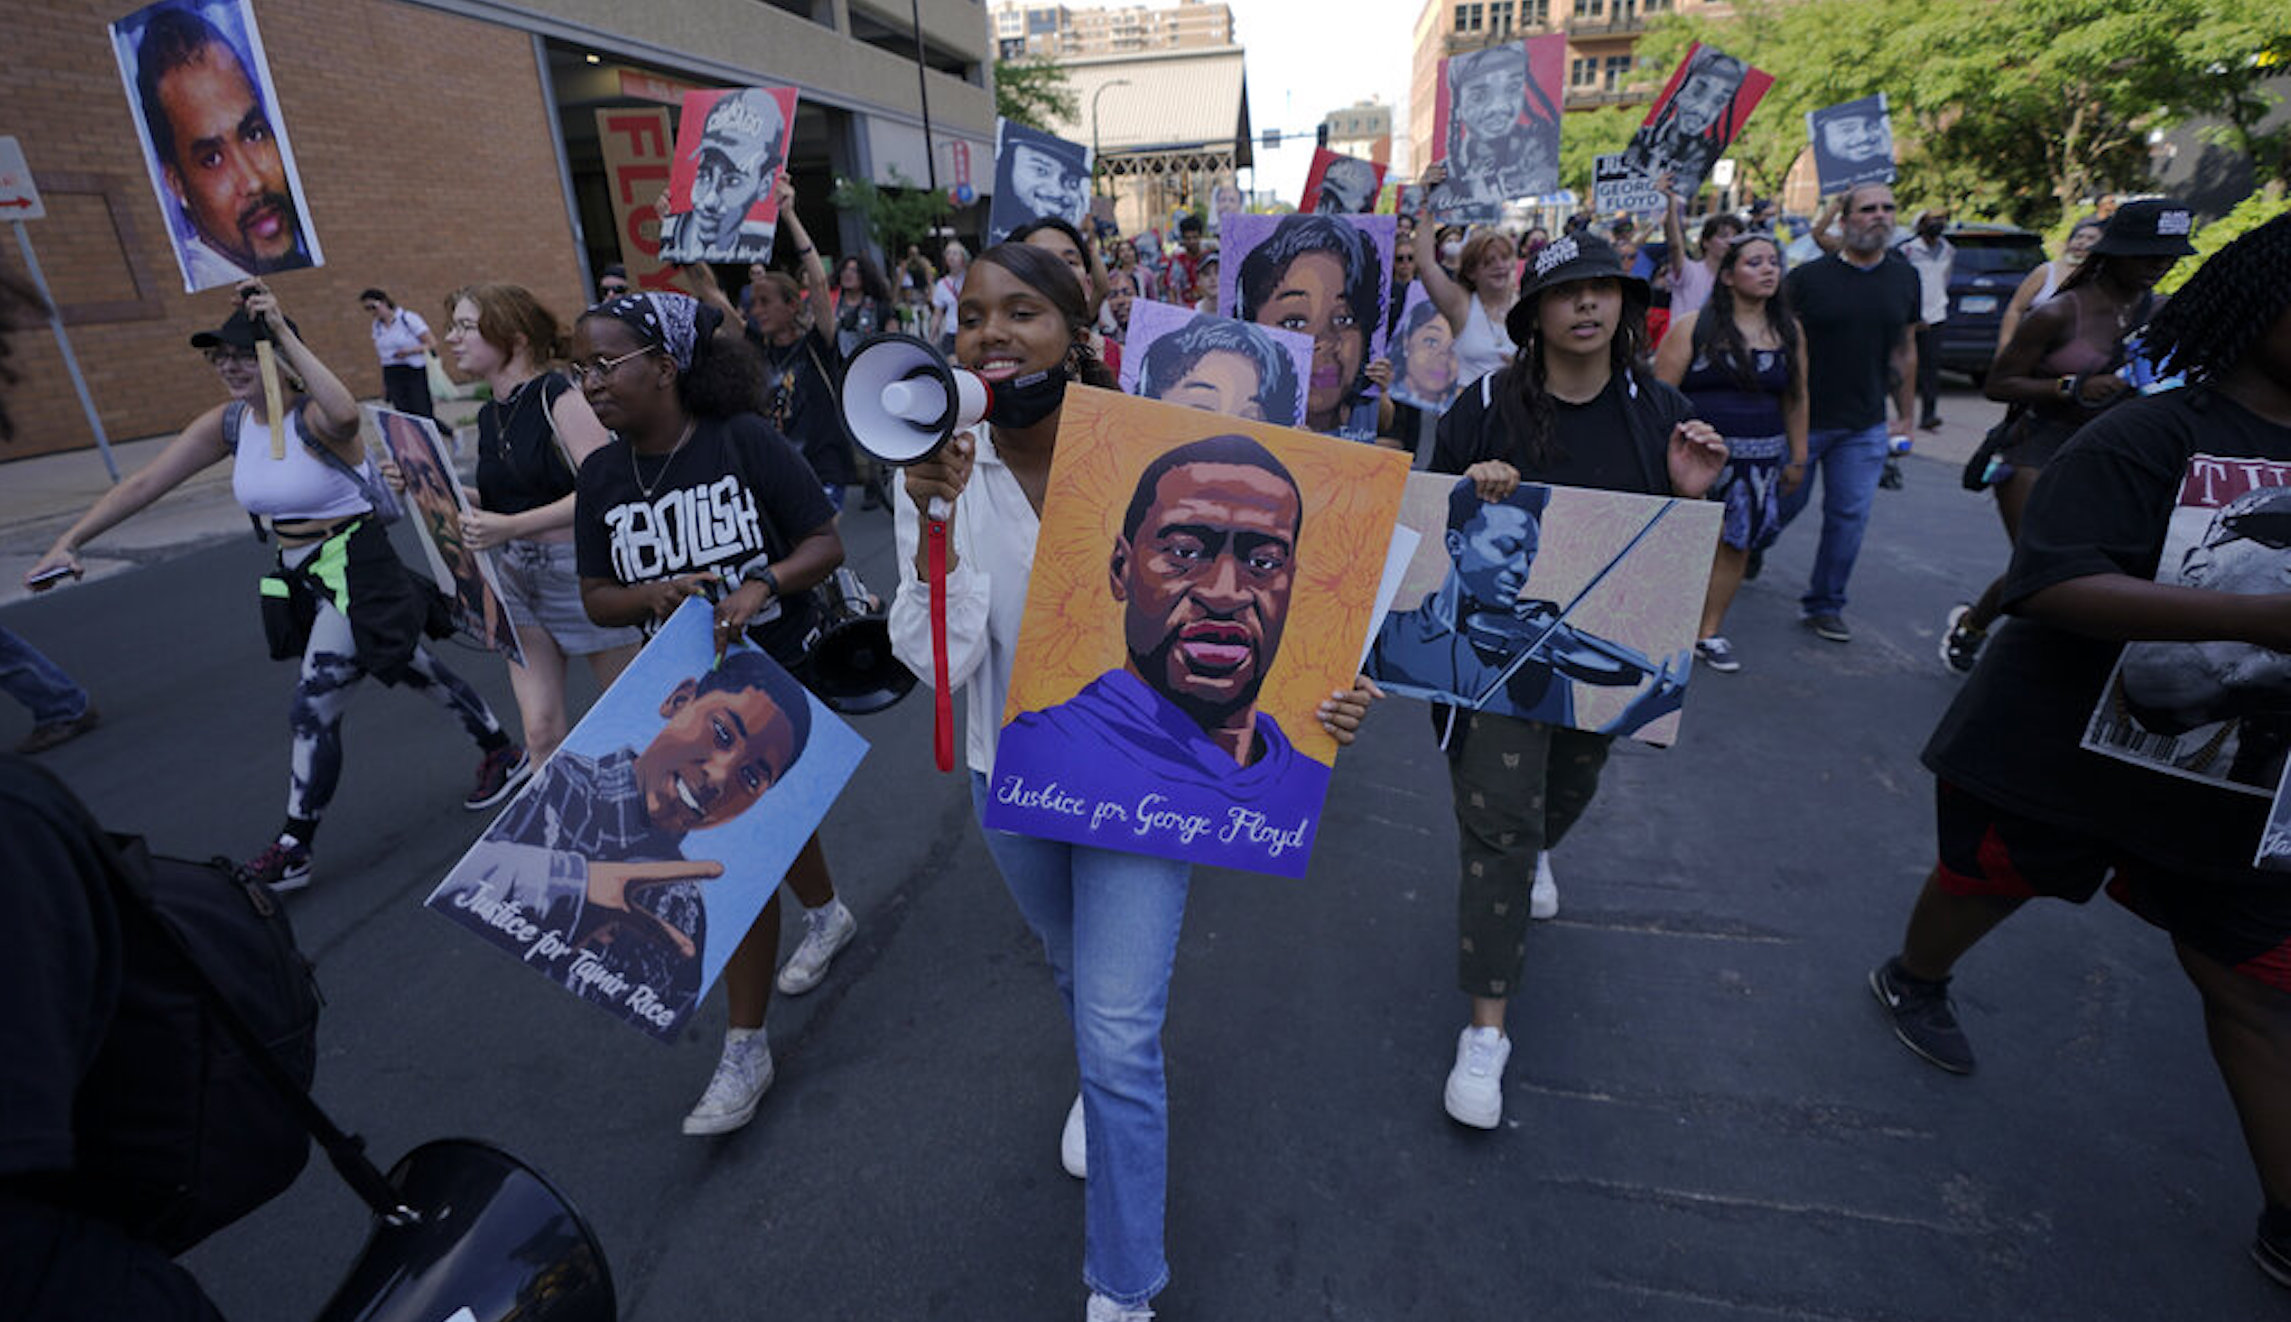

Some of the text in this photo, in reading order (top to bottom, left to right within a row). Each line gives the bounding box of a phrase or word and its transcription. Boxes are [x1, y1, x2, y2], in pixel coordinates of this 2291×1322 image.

[1607, 194, 1659, 209] FLOYD
[996, 775, 1310, 858] Justice for George Floyd
[454, 880, 677, 1027] Justice for Tamir Rice
